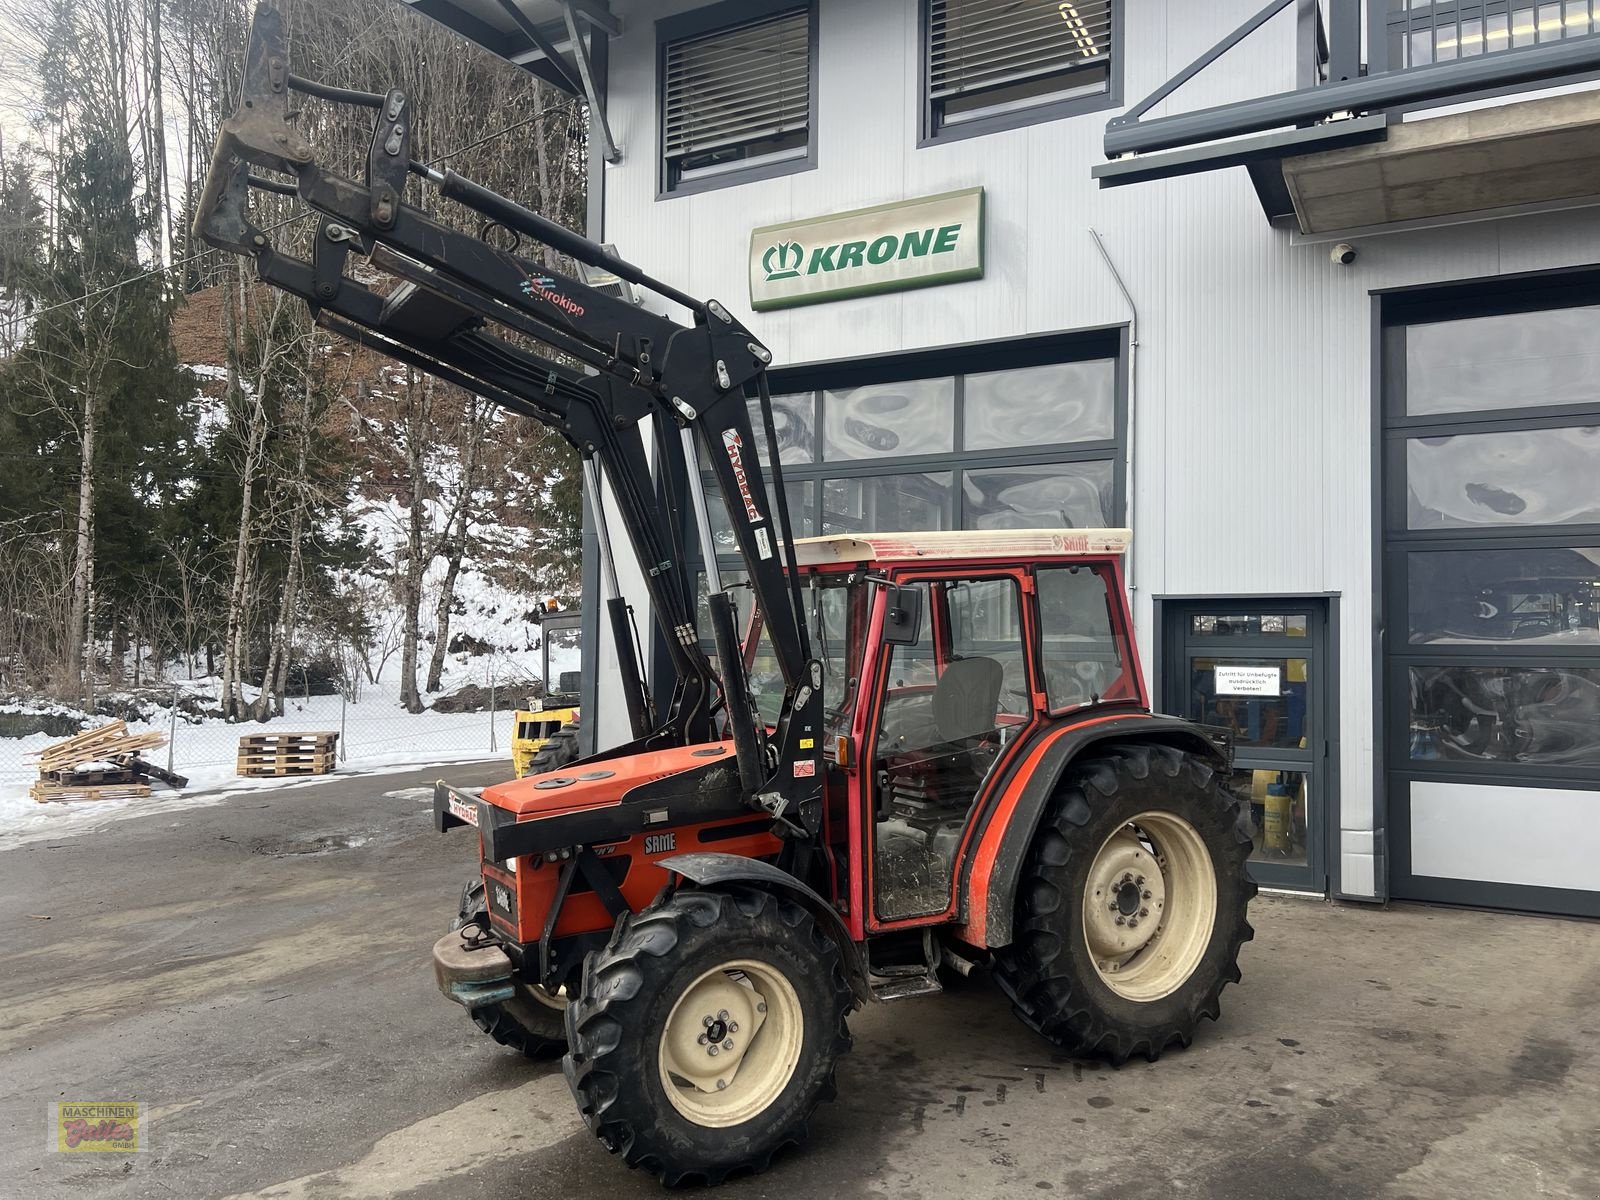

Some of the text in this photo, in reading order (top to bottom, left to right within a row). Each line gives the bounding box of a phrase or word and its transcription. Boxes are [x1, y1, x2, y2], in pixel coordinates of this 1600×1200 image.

[807, 223, 962, 275] KRONE
[727, 445, 758, 520] HYDRAC
[645, 833, 676, 855] SAME
